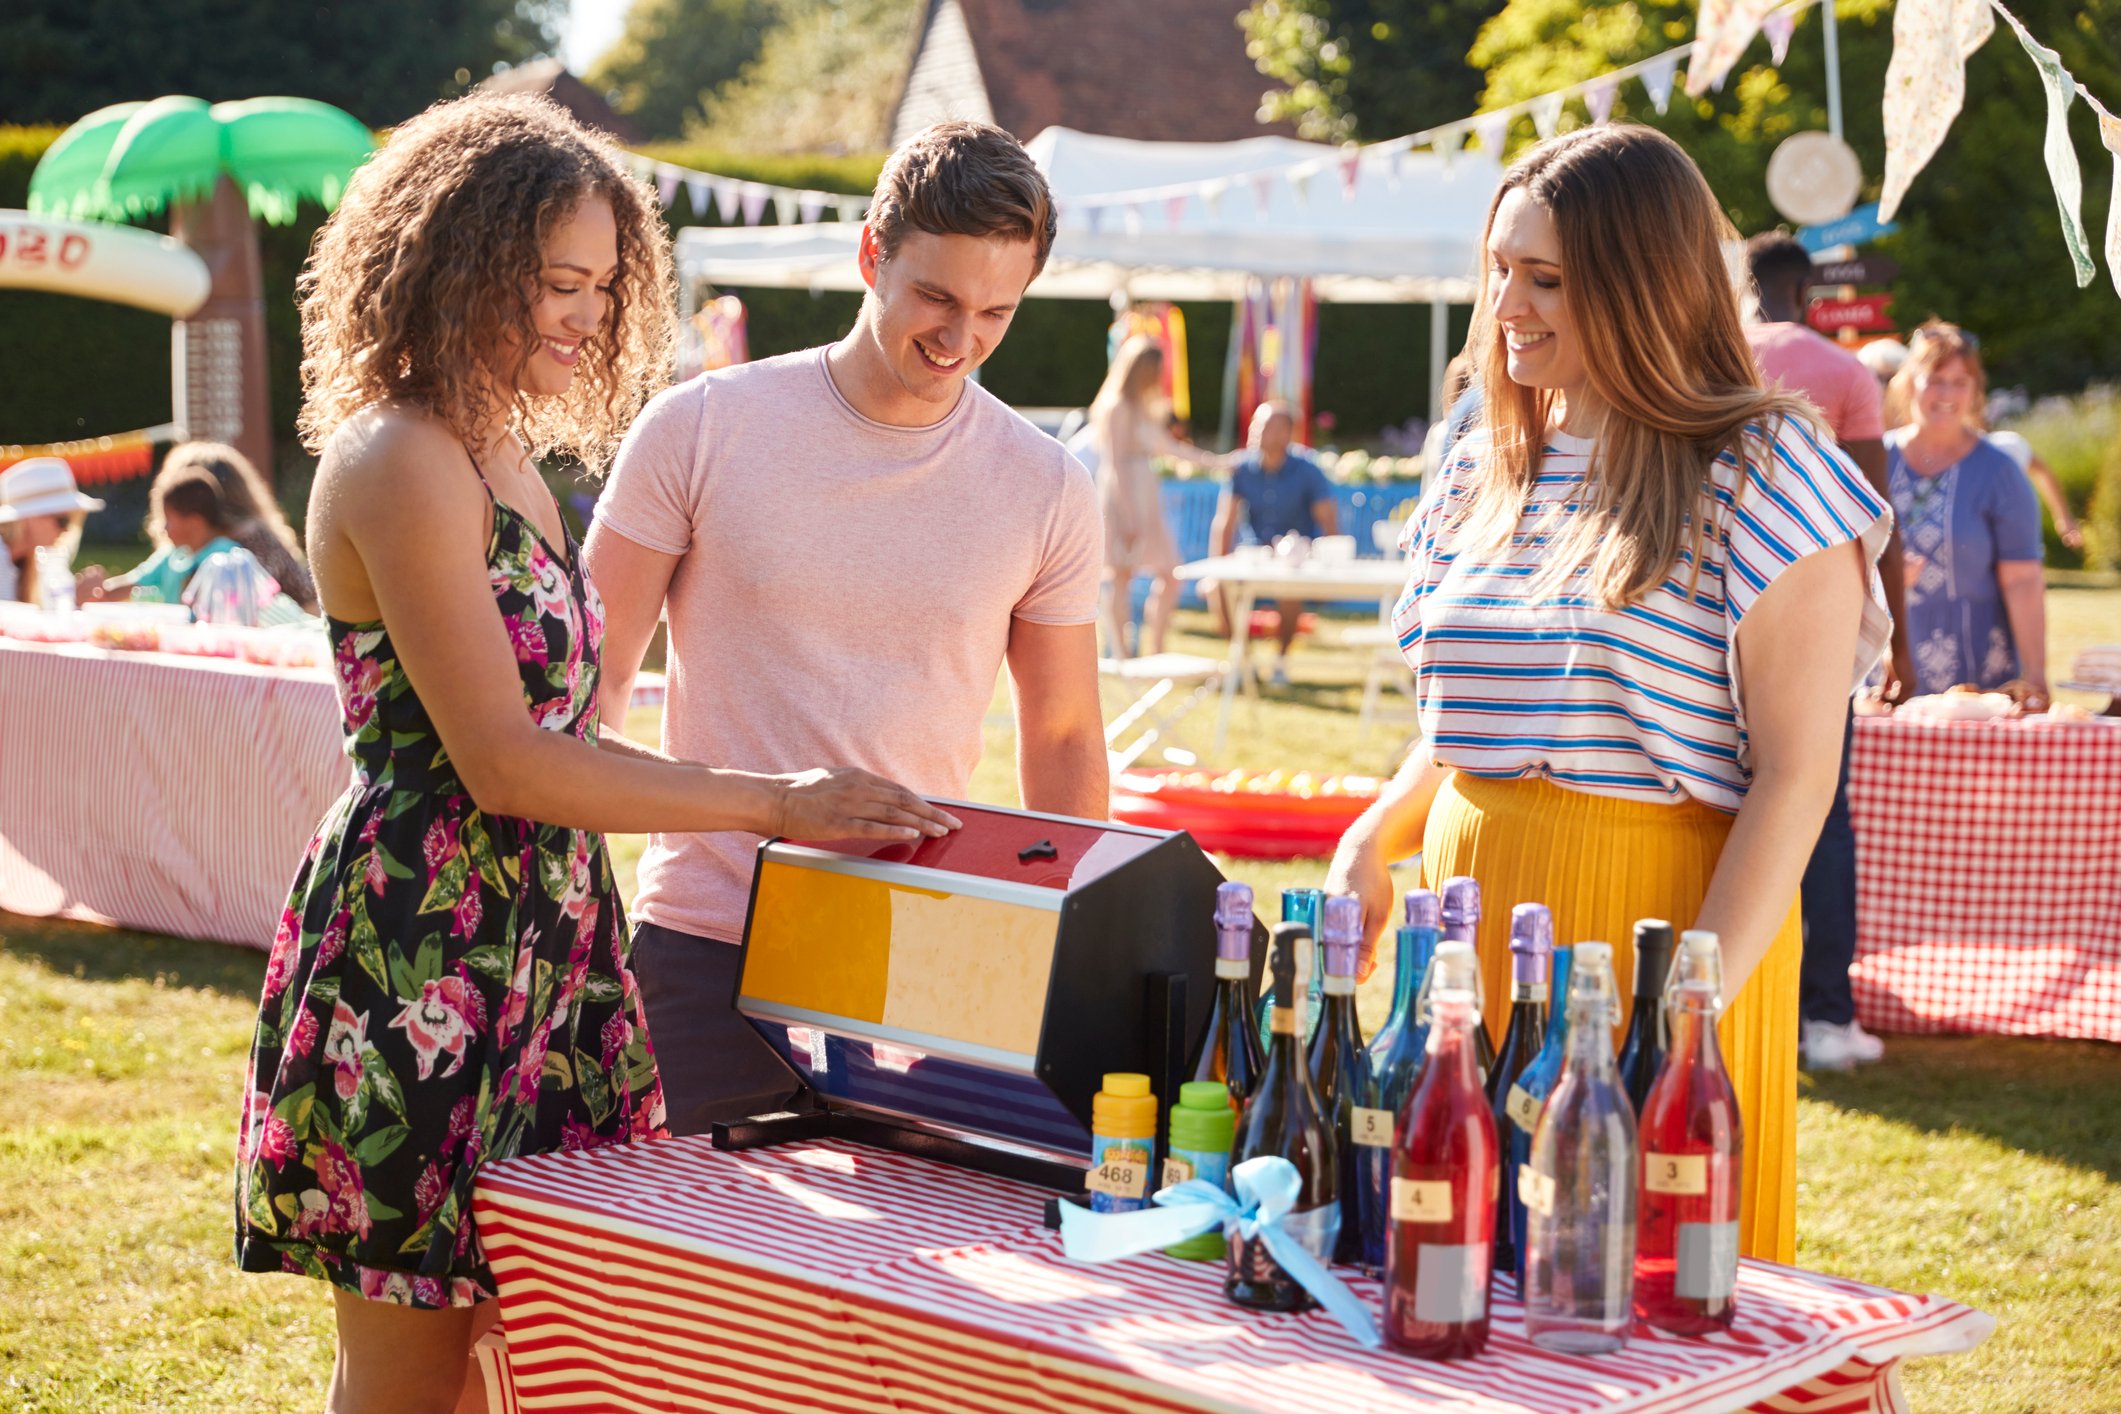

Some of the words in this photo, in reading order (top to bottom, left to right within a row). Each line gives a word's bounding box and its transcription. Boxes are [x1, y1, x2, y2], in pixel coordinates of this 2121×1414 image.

[1521, 1097, 1533, 1115] 6
[1366, 1114, 1375, 1132] 5
[1099, 1165, 1133, 1184] 468
[1666, 1161, 1678, 1180] 3
[1410, 1187, 1423, 1206] 4
